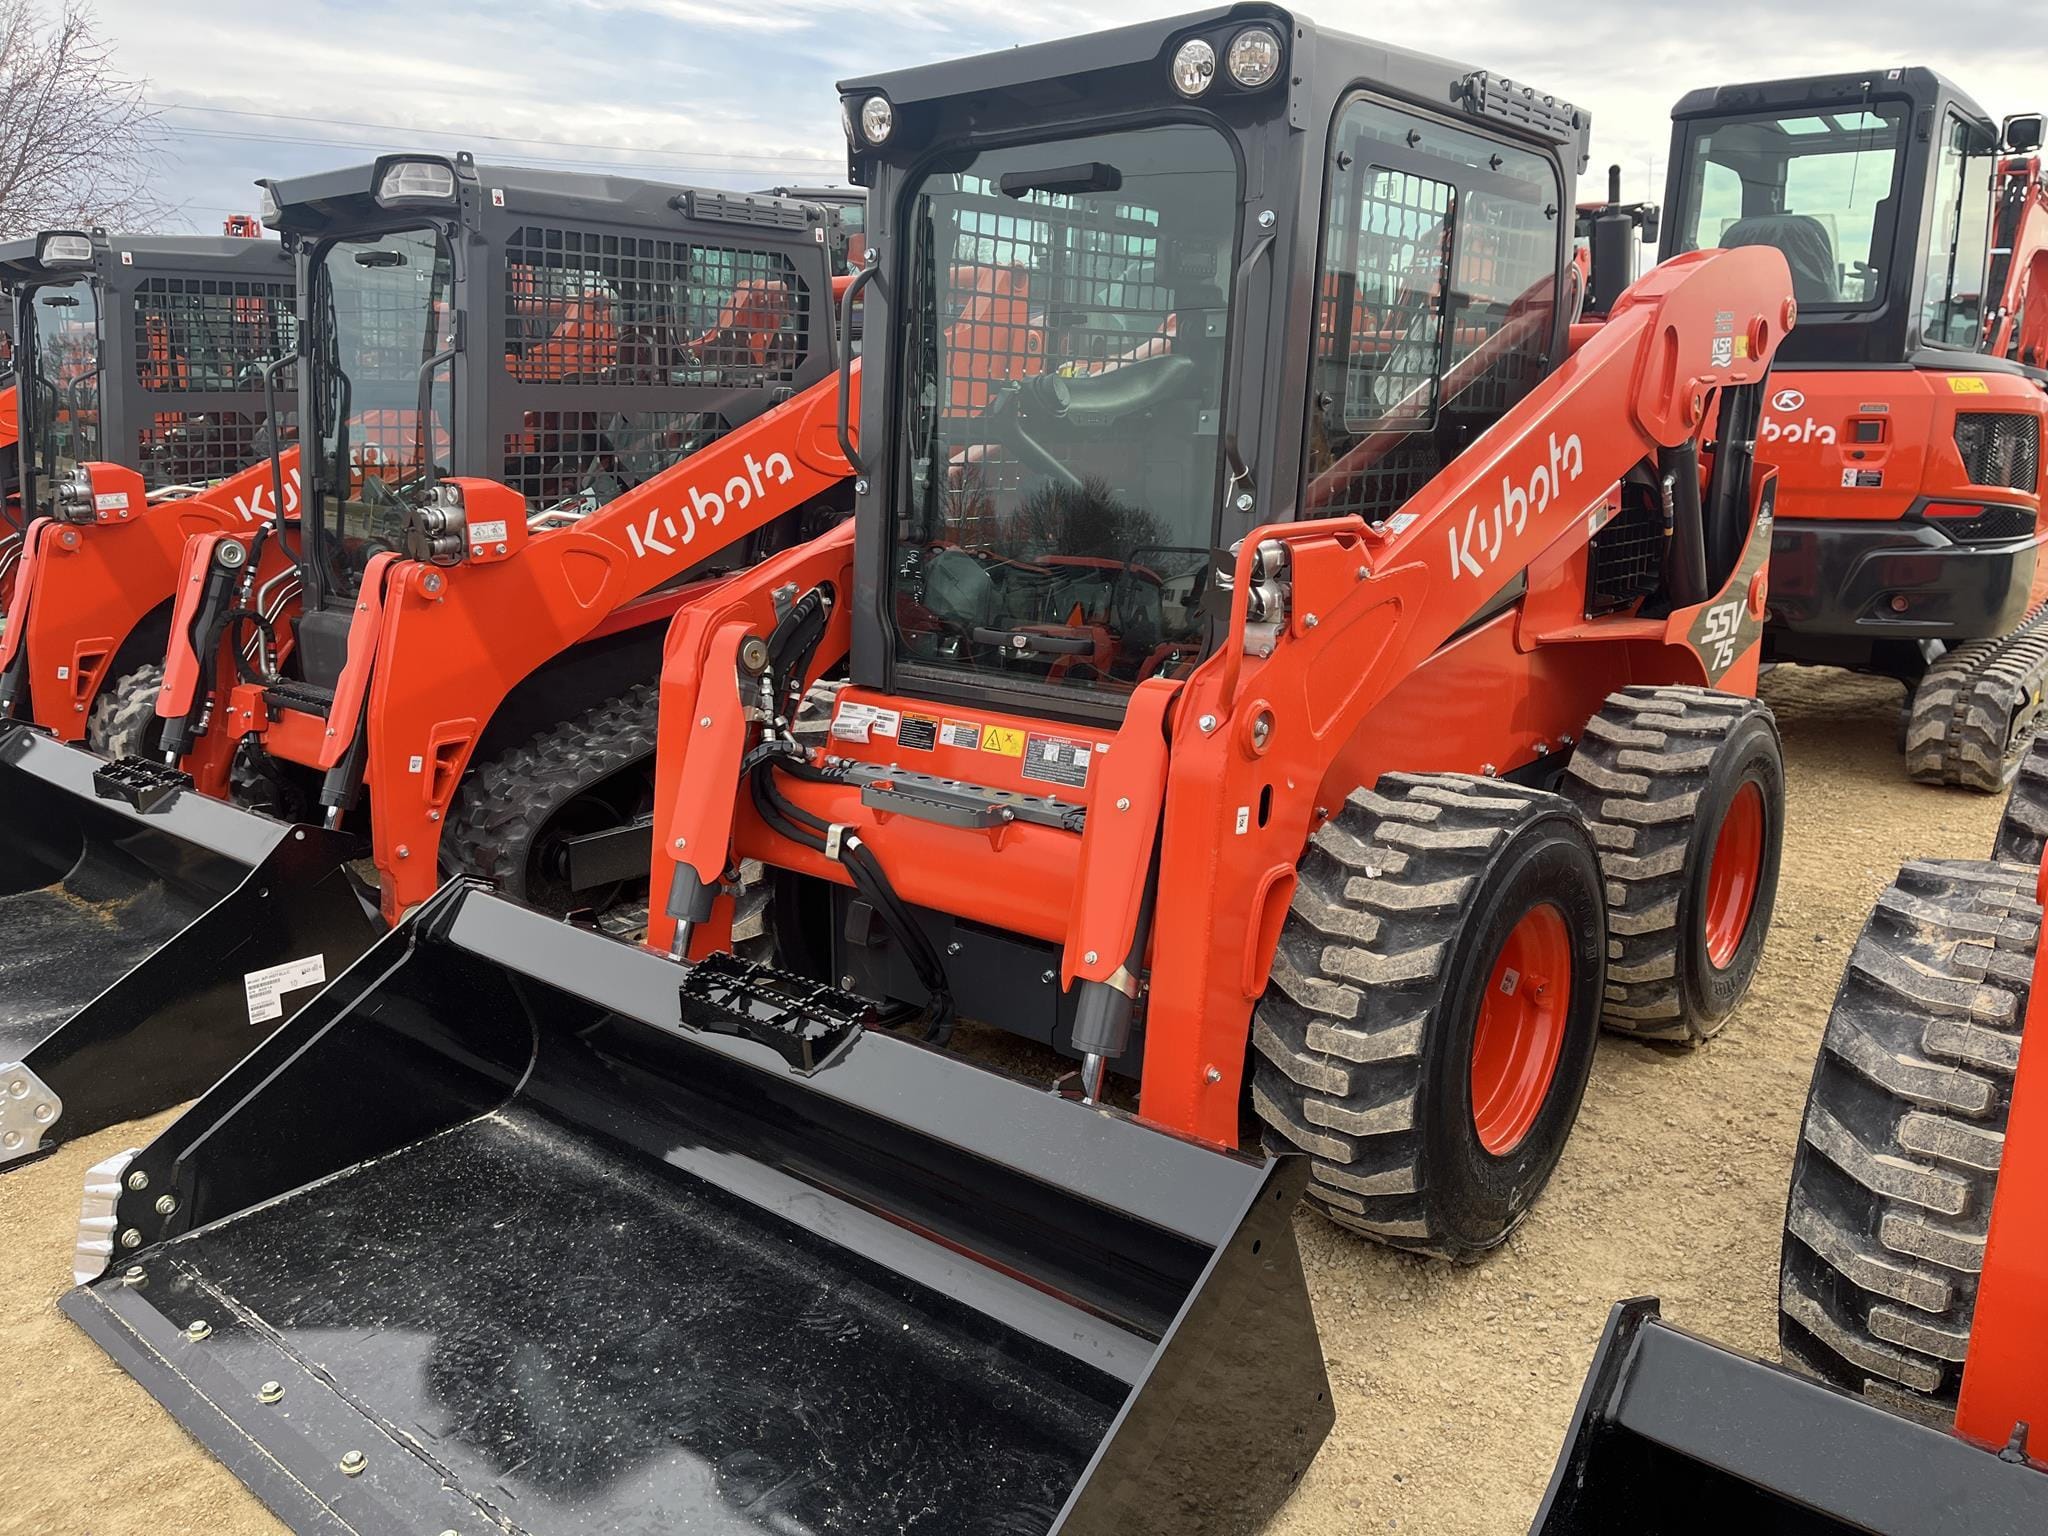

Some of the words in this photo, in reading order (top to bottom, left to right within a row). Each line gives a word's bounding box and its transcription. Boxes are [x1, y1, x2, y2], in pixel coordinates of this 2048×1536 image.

[1761, 416, 1837, 446] bota
[625, 452, 795, 559] Kubota
[1449, 431, 1583, 580] Kubota
[1700, 598, 1748, 645] SSV
[1711, 636, 1736, 672] 75
